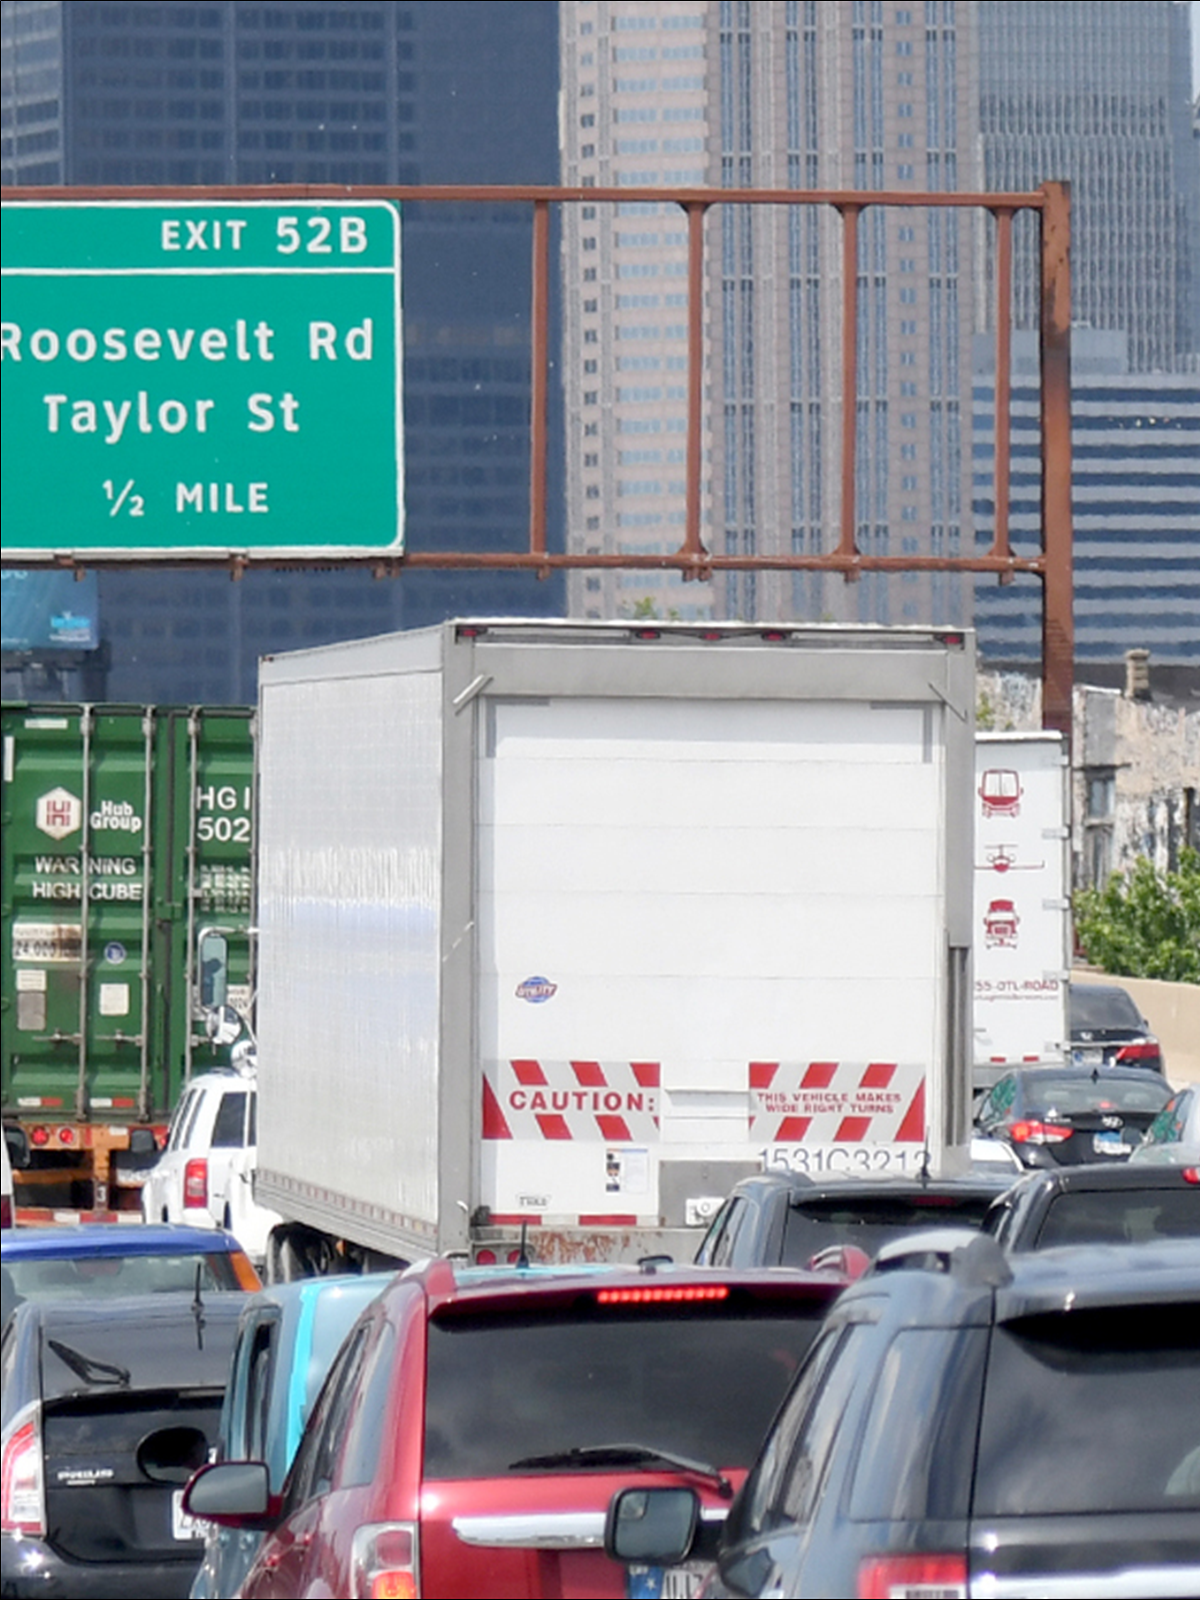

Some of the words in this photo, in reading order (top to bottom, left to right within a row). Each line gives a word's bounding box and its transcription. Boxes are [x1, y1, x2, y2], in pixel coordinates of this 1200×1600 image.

[161, 219, 248, 251] EXIT
[276, 216, 368, 255] 52B
[1, 319, 275, 363] Roosevelt
[308, 318, 373, 361] Rd
[43, 391, 215, 445] Taylor
[247, 393, 300, 433] St
[176, 483, 270, 513] MILE
[101, 800, 134, 817] Hub
[90, 812, 142, 834] Group
[196, 816, 251, 842] 502
[32, 882, 81, 899] HIGH
[88, 883, 143, 900] CUBE
[509, 1091, 655, 1112] CAUTION:
[757, 1092, 788, 1103] THIS
[793, 1092, 849, 1103] VEHICLE
[855, 1093, 902, 1103] MAKES
[765, 1103, 799, 1114] WIDE
[804, 1104, 845, 1114] RIGHT
[850, 1104, 894, 1114] TURNS
